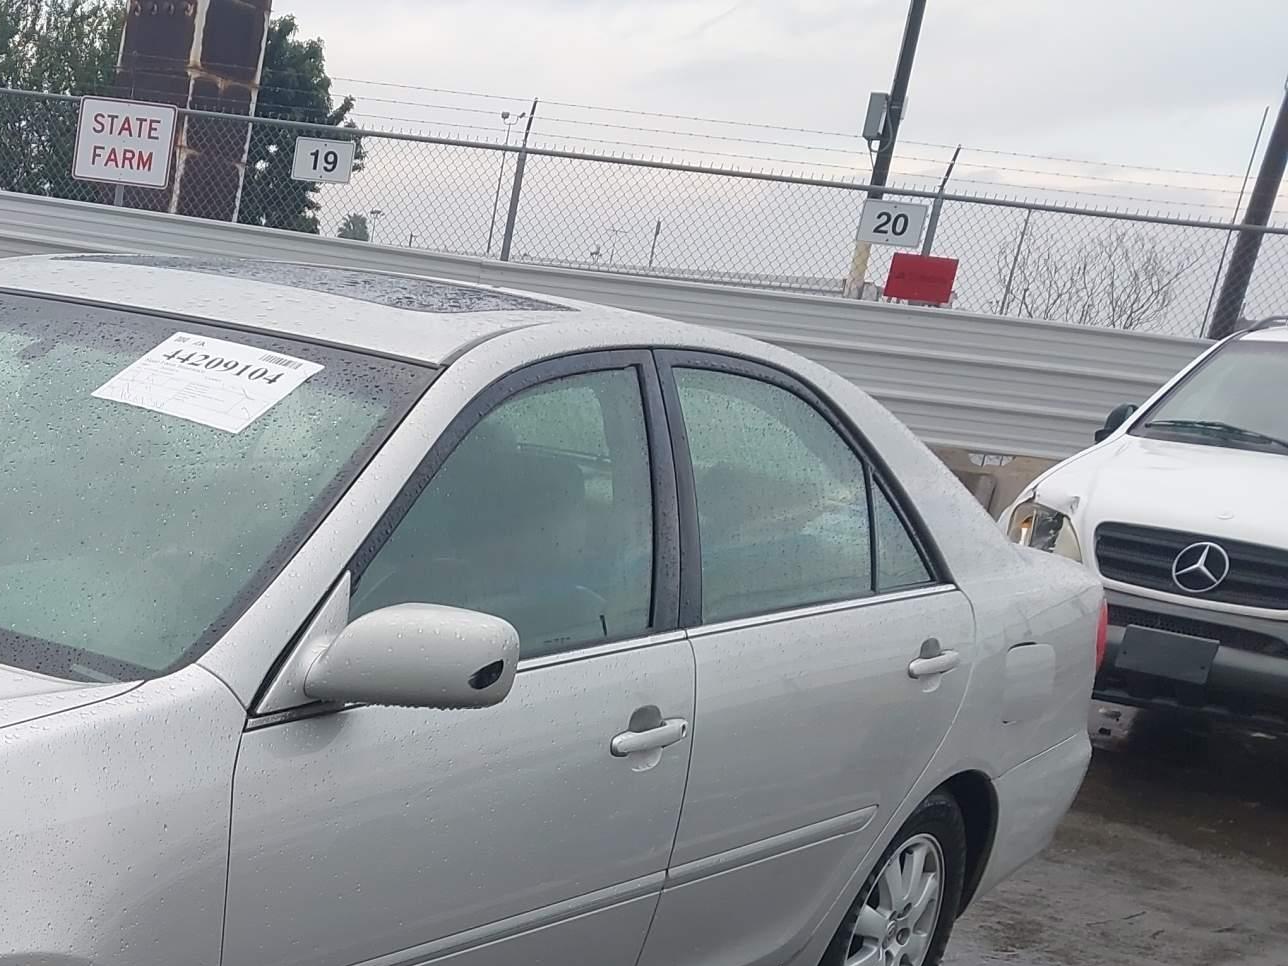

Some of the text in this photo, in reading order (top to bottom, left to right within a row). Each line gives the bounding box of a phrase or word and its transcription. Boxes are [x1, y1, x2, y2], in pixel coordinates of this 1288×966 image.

[92, 113, 161, 140] STATE
[91, 145, 153, 172] FARM
[310, 149, 338, 172] 19
[872, 211, 909, 236] 20
[162, 348, 285, 384] 44209104
